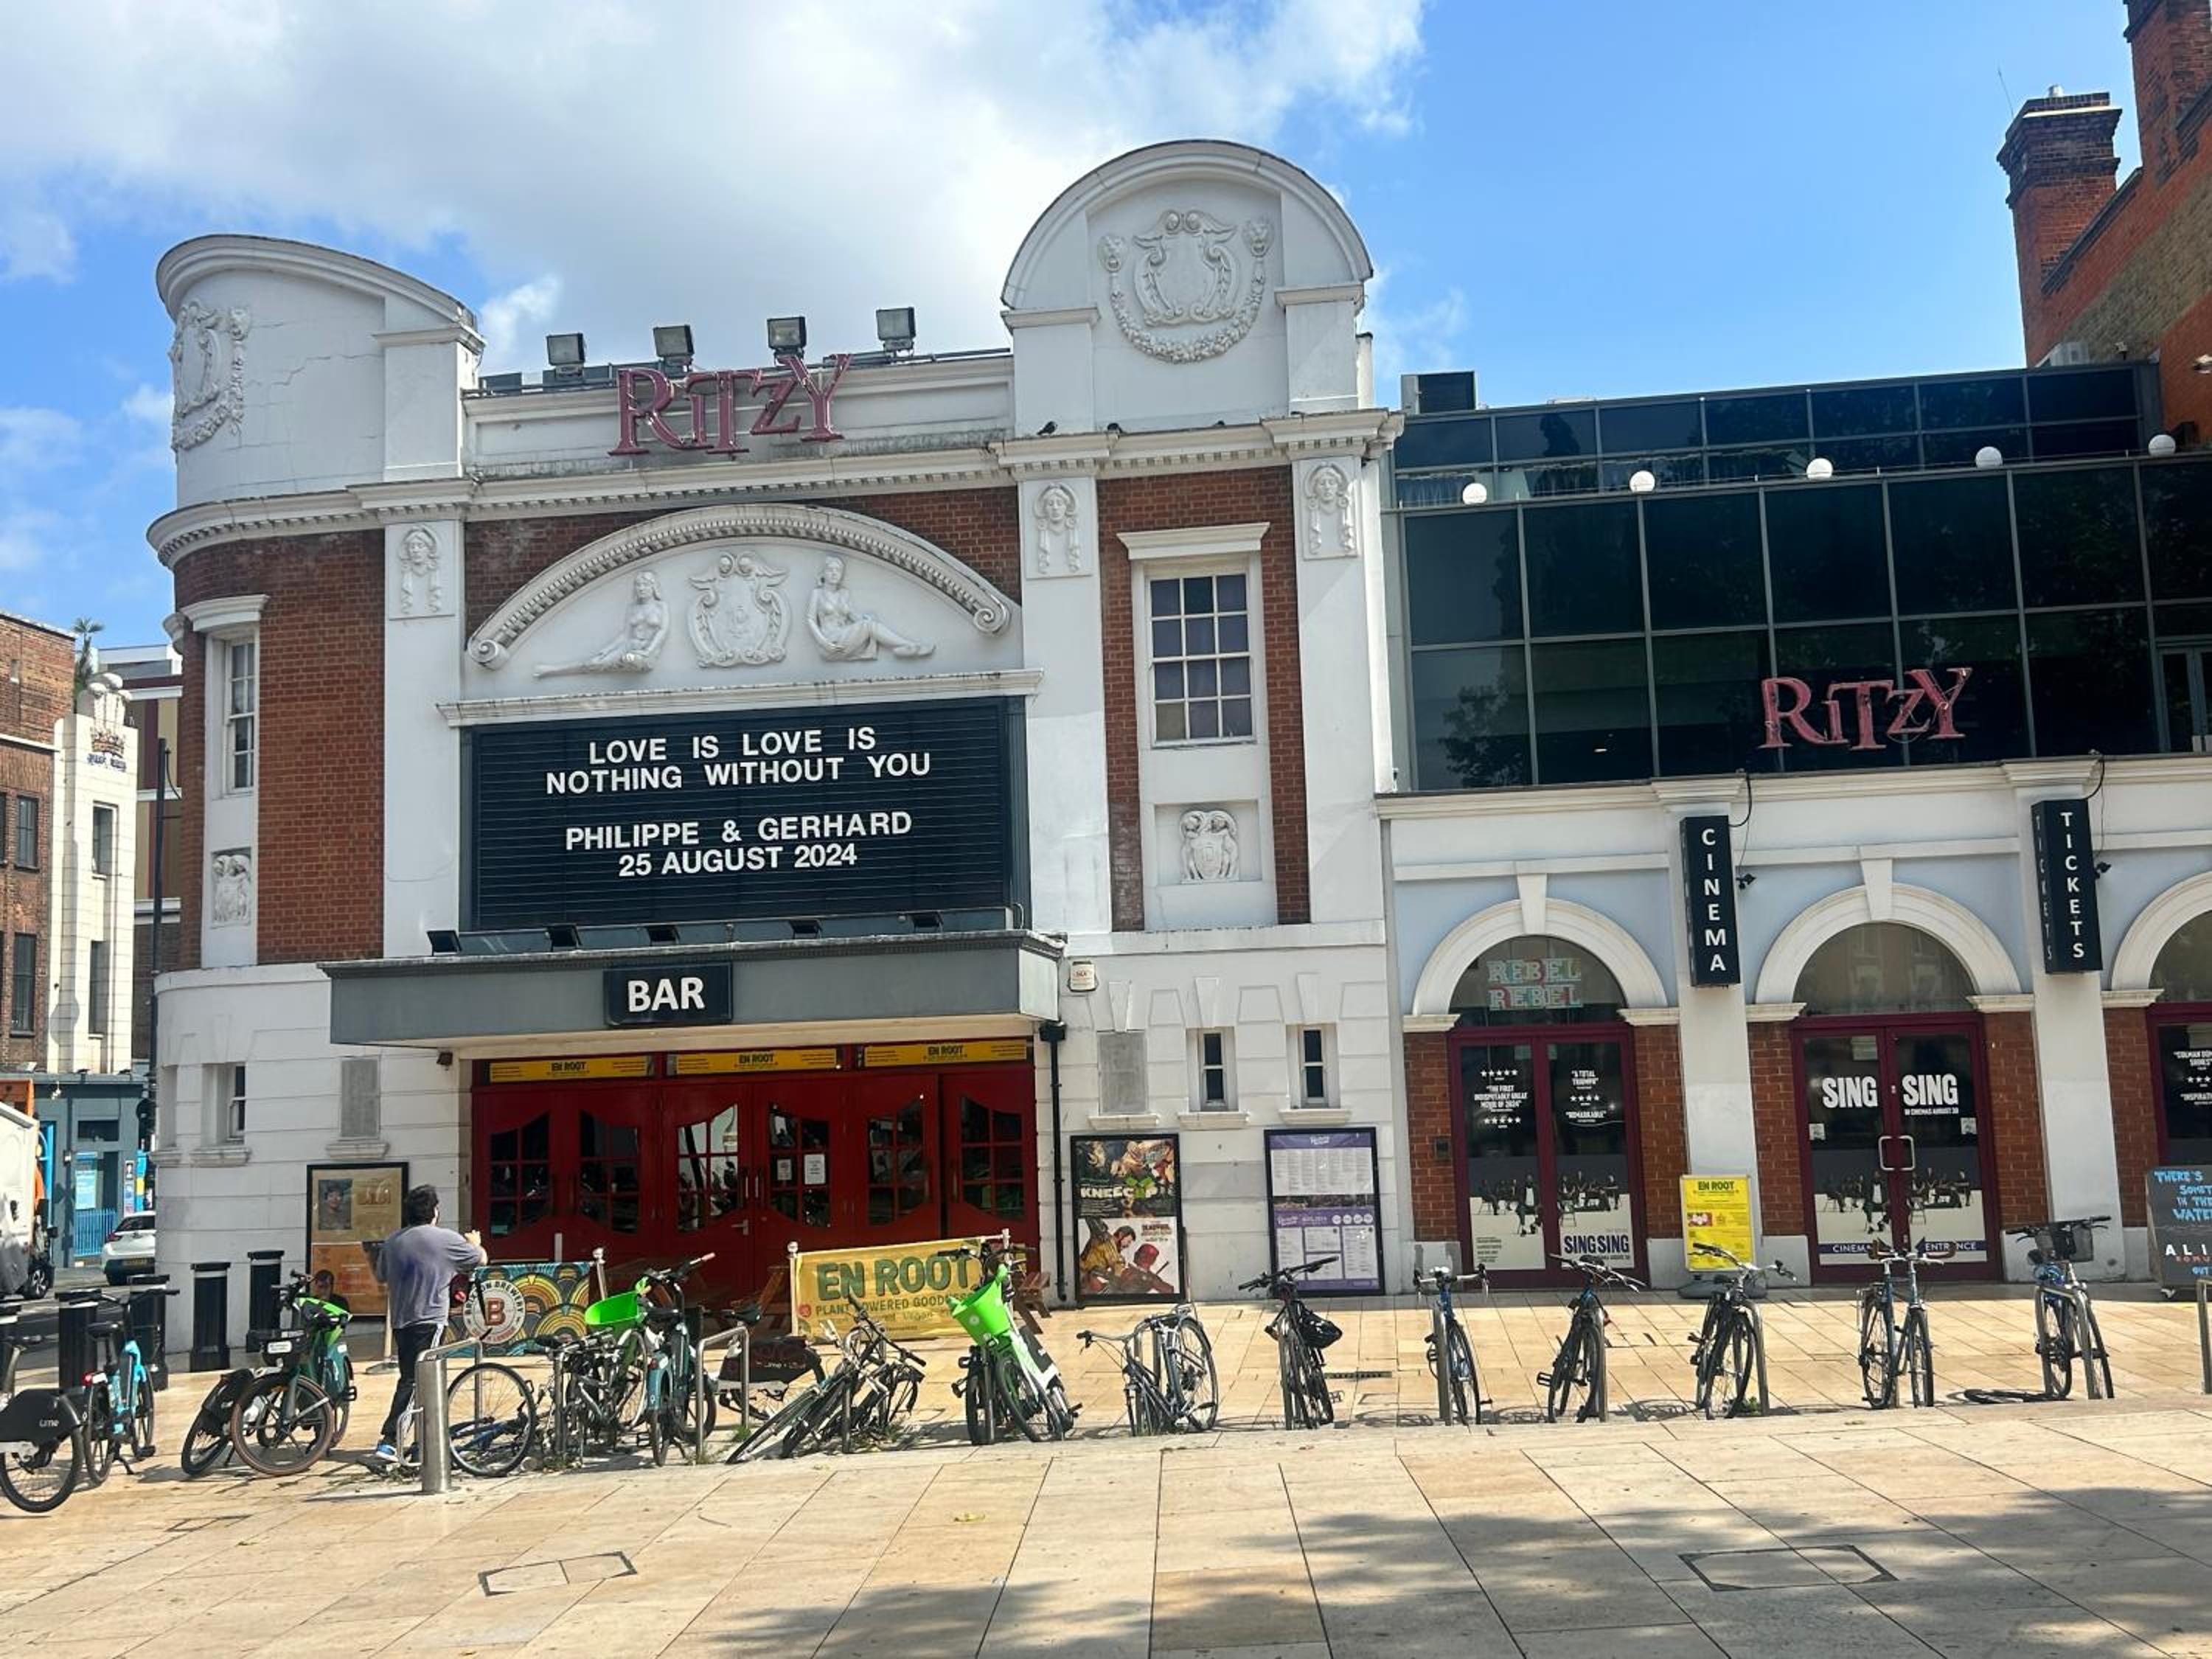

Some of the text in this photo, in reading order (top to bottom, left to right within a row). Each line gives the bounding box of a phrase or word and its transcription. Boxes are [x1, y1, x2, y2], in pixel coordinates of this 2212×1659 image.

[589, 727, 876, 765] LOVE IS LOVE IS
[546, 753, 931, 794] NOTHING WITHOUT YOU
[566, 811, 912, 850] PHILIPPE & GERHARD
[619, 843, 858, 877] 25 AUGUST 2024
[1701, 828, 1727, 972] CINEMA
[2060, 812, 2085, 958] TICKETS
[1486, 959, 1582, 984] REBEL
[628, 977, 706, 1012] BAR
[1488, 984, 1583, 1011] REBEL
[1822, 1074, 1959, 1108] SING SING
[1711, 1181, 1734, 1190] ROOT
[1564, 1235, 1630, 1253] SING SING
[1925, 1242, 1977, 1251] ENTRNCE
[817, 1256, 974, 1301] EN ROOT
[485, 1298, 507, 1326] B
[860, 1298, 909, 1312] OWERED
